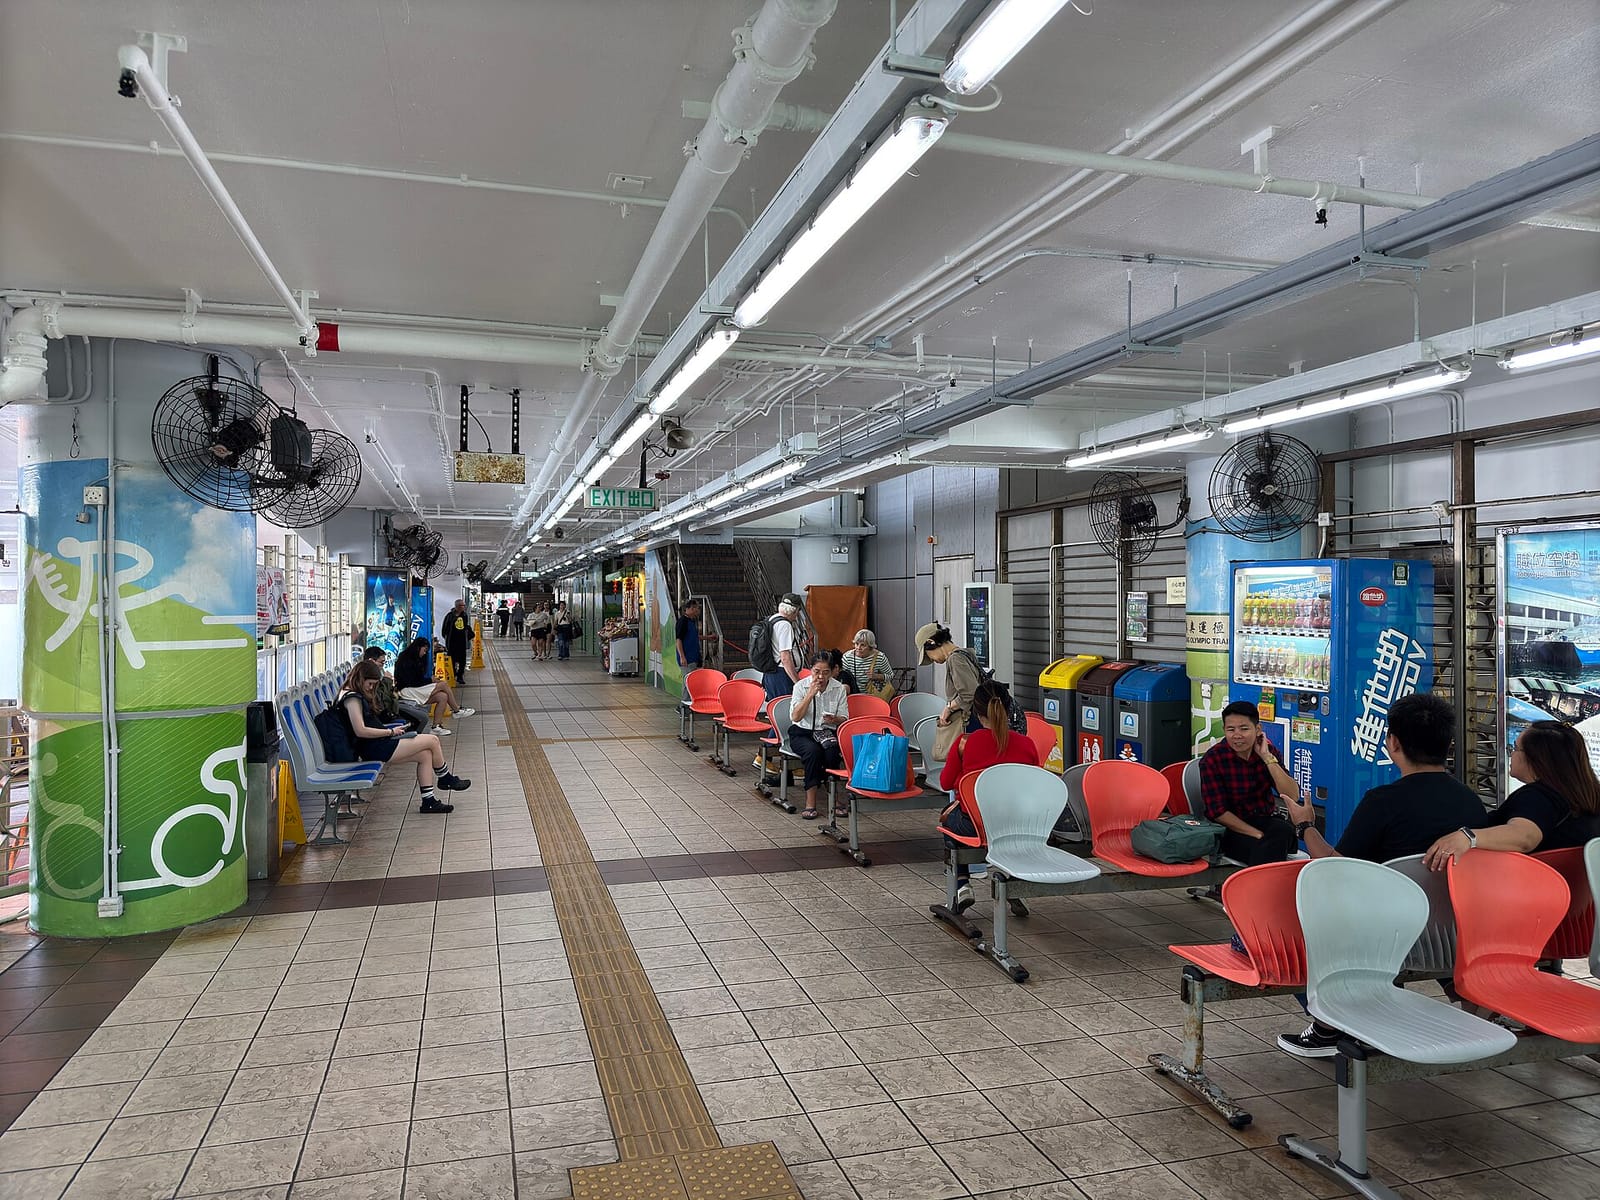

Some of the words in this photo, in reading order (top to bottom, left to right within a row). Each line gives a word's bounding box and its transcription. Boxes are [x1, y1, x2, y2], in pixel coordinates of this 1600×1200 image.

[592, 489, 625, 506] EXIT
[628, 490, 653, 507] 出口
[1516, 550, 1580, 570] 職位空缺
[1190, 636, 1211, 645] OLYMPIC
[1211, 637, 1229, 645] TRAI
